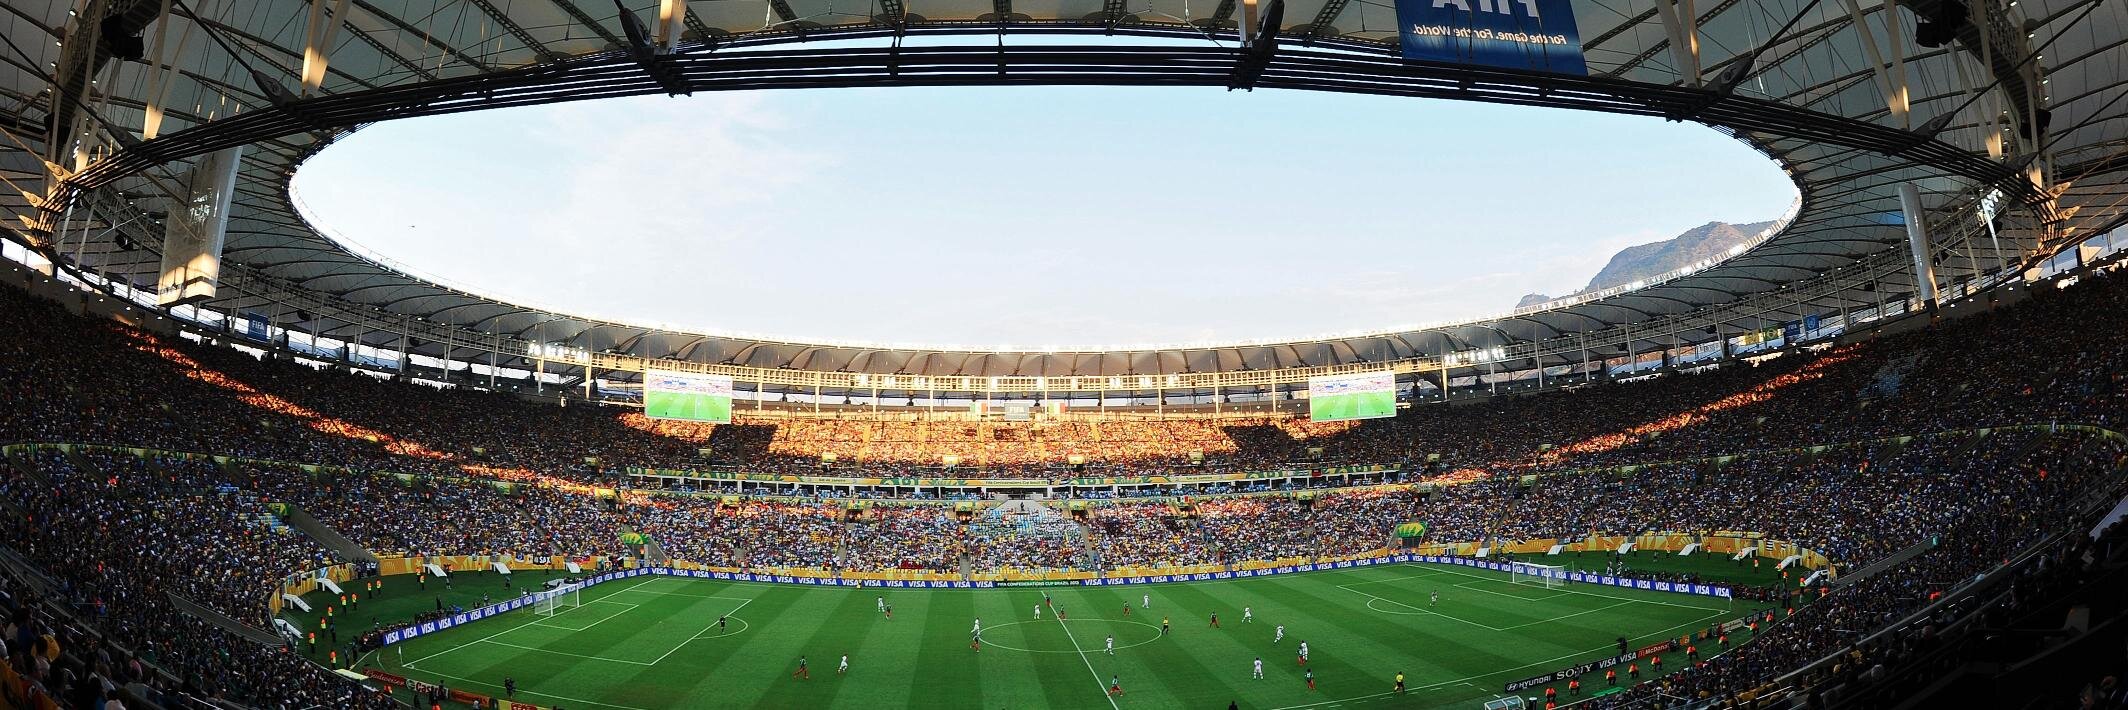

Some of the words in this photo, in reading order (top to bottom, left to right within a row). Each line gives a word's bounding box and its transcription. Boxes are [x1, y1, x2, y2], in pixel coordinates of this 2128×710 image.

[252, 320, 265, 330] FIFA
[693, 570, 709, 578] VISA
[714, 572, 730, 580] VISA
[735, 573, 750, 581] VISA
[1257, 568, 1272, 576] VISA
[1277, 566, 1292, 574] VISA
[1514, 566, 1524, 574] VISA
[1527, 567, 1537, 576] VISA
[1556, 570, 1566, 579] VISA
[1570, 572, 1581, 582] VISA
[1586, 574, 1597, 584] VISA
[1602, 576, 1614, 586] VISA
[1619, 578, 1632, 588] VISA
[1637, 580, 1650, 589] VISA
[1655, 582, 1669, 592] VISA
[1675, 583, 1689, 594] VISA
[1695, 585, 1709, 595] VISA
[1715, 587, 1729, 598] VISA
[386, 631, 399, 645] VISA
[403, 625, 417, 641] VISA
[422, 621, 435, 635] VISA
[439, 618, 451, 630] VISA
[455, 613, 466, 625] VISA
[470, 610, 481, 621] VISA
[485, 606, 495, 617] VISA
[499, 603, 508, 613] VISA
[512, 599, 521, 609] VISA
[524, 595, 532, 605] VISA
[615, 571, 624, 579] VISA
[1599, 658, 1616, 669] VISA
[1620, 652, 1637, 663] VISA
[1519, 676, 1551, 689] HYUNDAI
